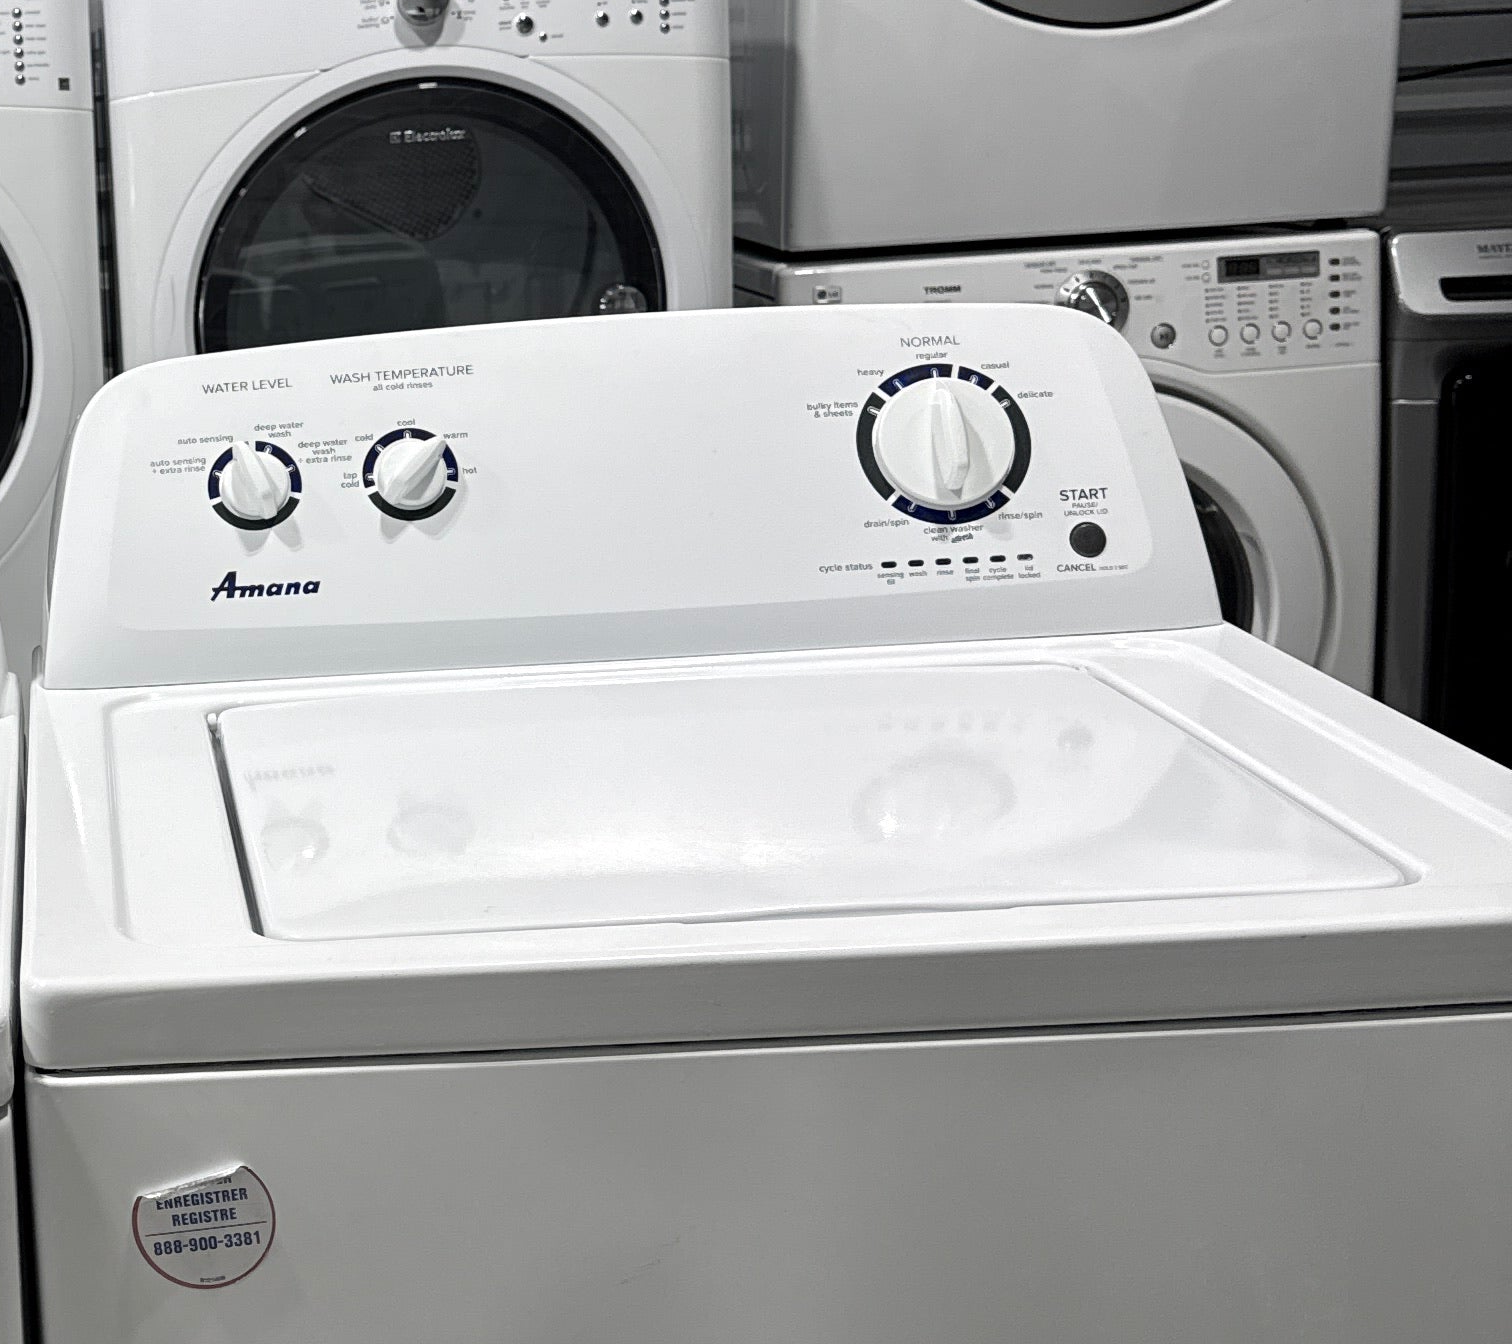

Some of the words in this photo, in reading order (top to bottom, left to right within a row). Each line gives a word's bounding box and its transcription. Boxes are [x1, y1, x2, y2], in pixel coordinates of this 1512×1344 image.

[923, 284, 962, 296] TROMM
[900, 336, 961, 348] NORMAL
[915, 351, 948, 361] regular
[981, 361, 1010, 370] casual
[330, 371, 371, 386] WASH
[375, 364, 475, 383] TEMPERATURE
[856, 369, 884, 378] heavy
[202, 381, 249, 395] WATER
[252, 378, 293, 392] LEVEL
[372, 383, 384, 392] all
[386, 382, 405, 392] cold
[406, 381, 433, 390] rinses
[1017, 390, 1054, 399] delicate
[806, 403, 832, 412] bulky
[833, 401, 859, 409] items
[823, 409, 854, 418] sheets
[254, 423, 275, 433] deep
[278, 421, 304, 431] water
[397, 418, 416, 427] cool
[177, 436, 197, 445] auto
[199, 434, 234, 445] sensing
[268, 429, 292, 439] wash
[355, 433, 374, 442] cold
[443, 431, 469, 440] warm
[298, 440, 320, 450] deep
[322, 438, 348, 447] water
[312, 446, 336, 456] wash
[149, 458, 170, 468] auto
[172, 456, 206, 467] sensing
[305, 455, 327, 464] extra
[328, 453, 353, 463] rinse
[159, 466, 181, 475] extra
[182, 464, 206, 473] rinse
[462, 466, 478, 475] hot
[343, 471, 358, 481] tap
[341, 479, 360, 489] cold
[1059, 487, 1108, 502] START
[997, 510, 1044, 521] rinse/spin
[1064, 509, 1095, 517] UNLOCK
[863, 517, 911, 529] drain/spin
[923, 525, 948, 535] clean
[950, 523, 985, 533] washer
[819, 563, 843, 574] cycle
[845, 562, 874, 572] status
[1056, 563, 1097, 573] CANCEL
[210, 570, 321, 602] Amana
[171, 1207, 238, 1227] REGISTRE
[153, 1230, 261, 1256] 888-900-3381
